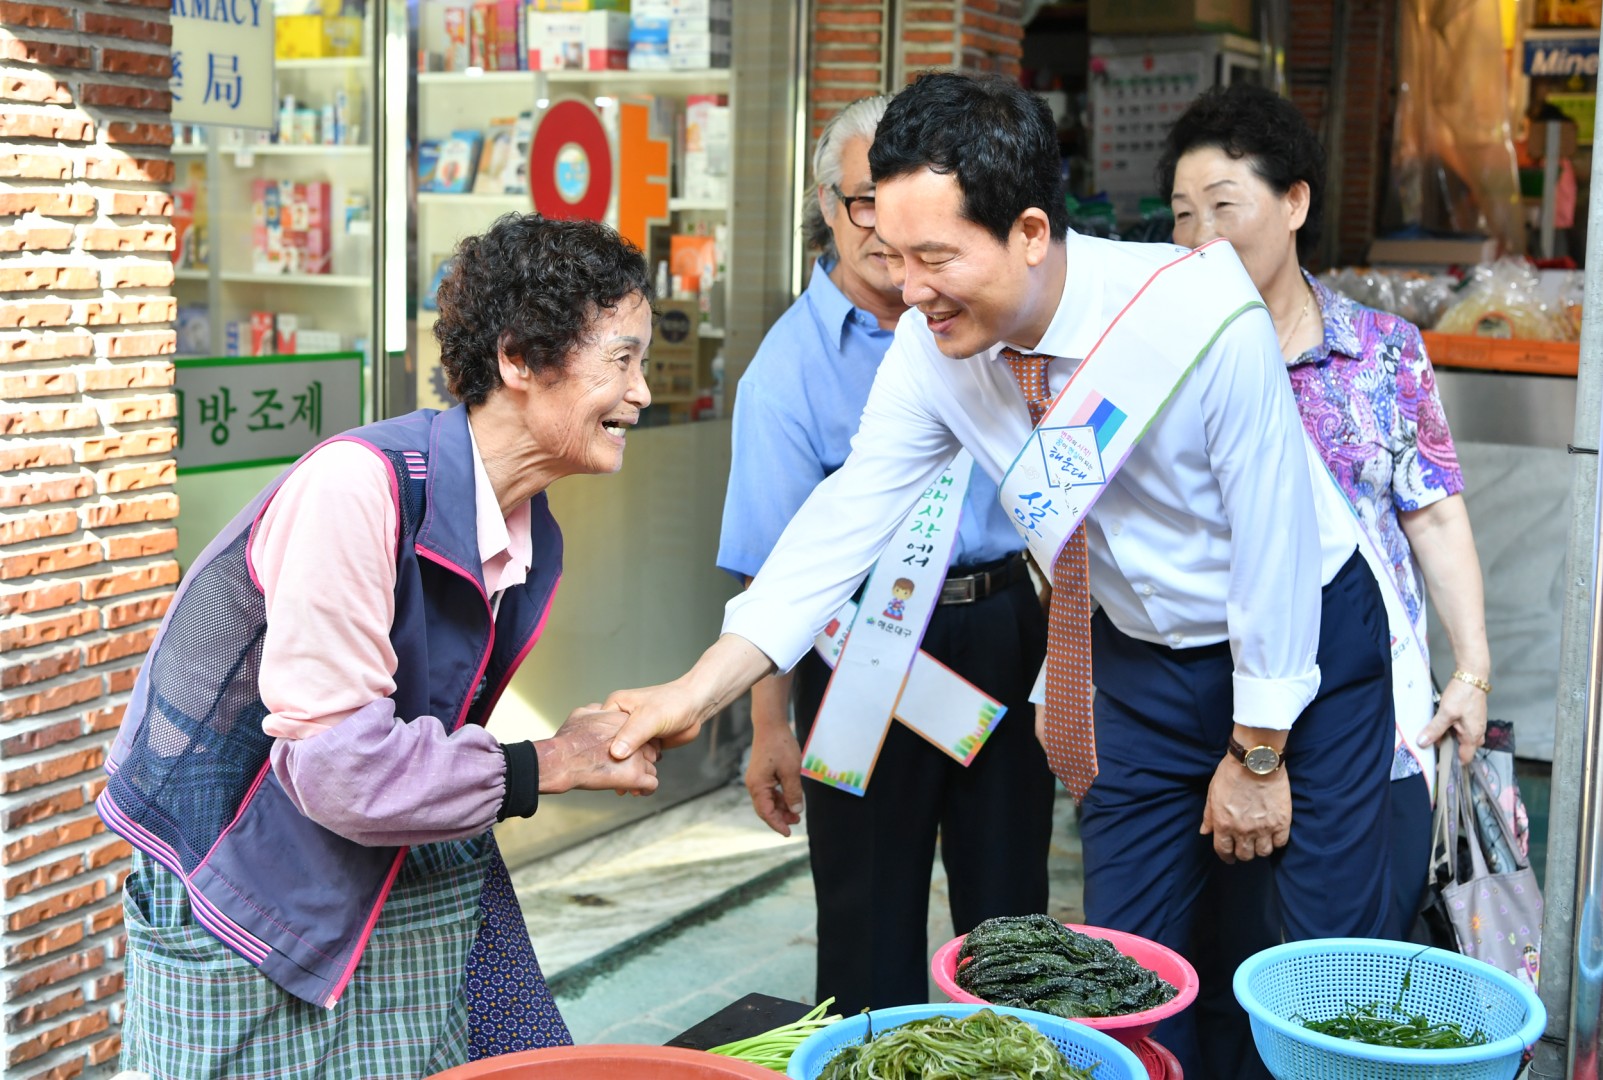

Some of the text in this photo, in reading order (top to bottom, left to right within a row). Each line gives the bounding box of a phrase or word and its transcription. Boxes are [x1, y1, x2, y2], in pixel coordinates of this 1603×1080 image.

[1049, 446, 1087, 480] 해운대
[877, 620, 912, 638] 해운대구
[1392, 636, 1410, 661] 운대구
